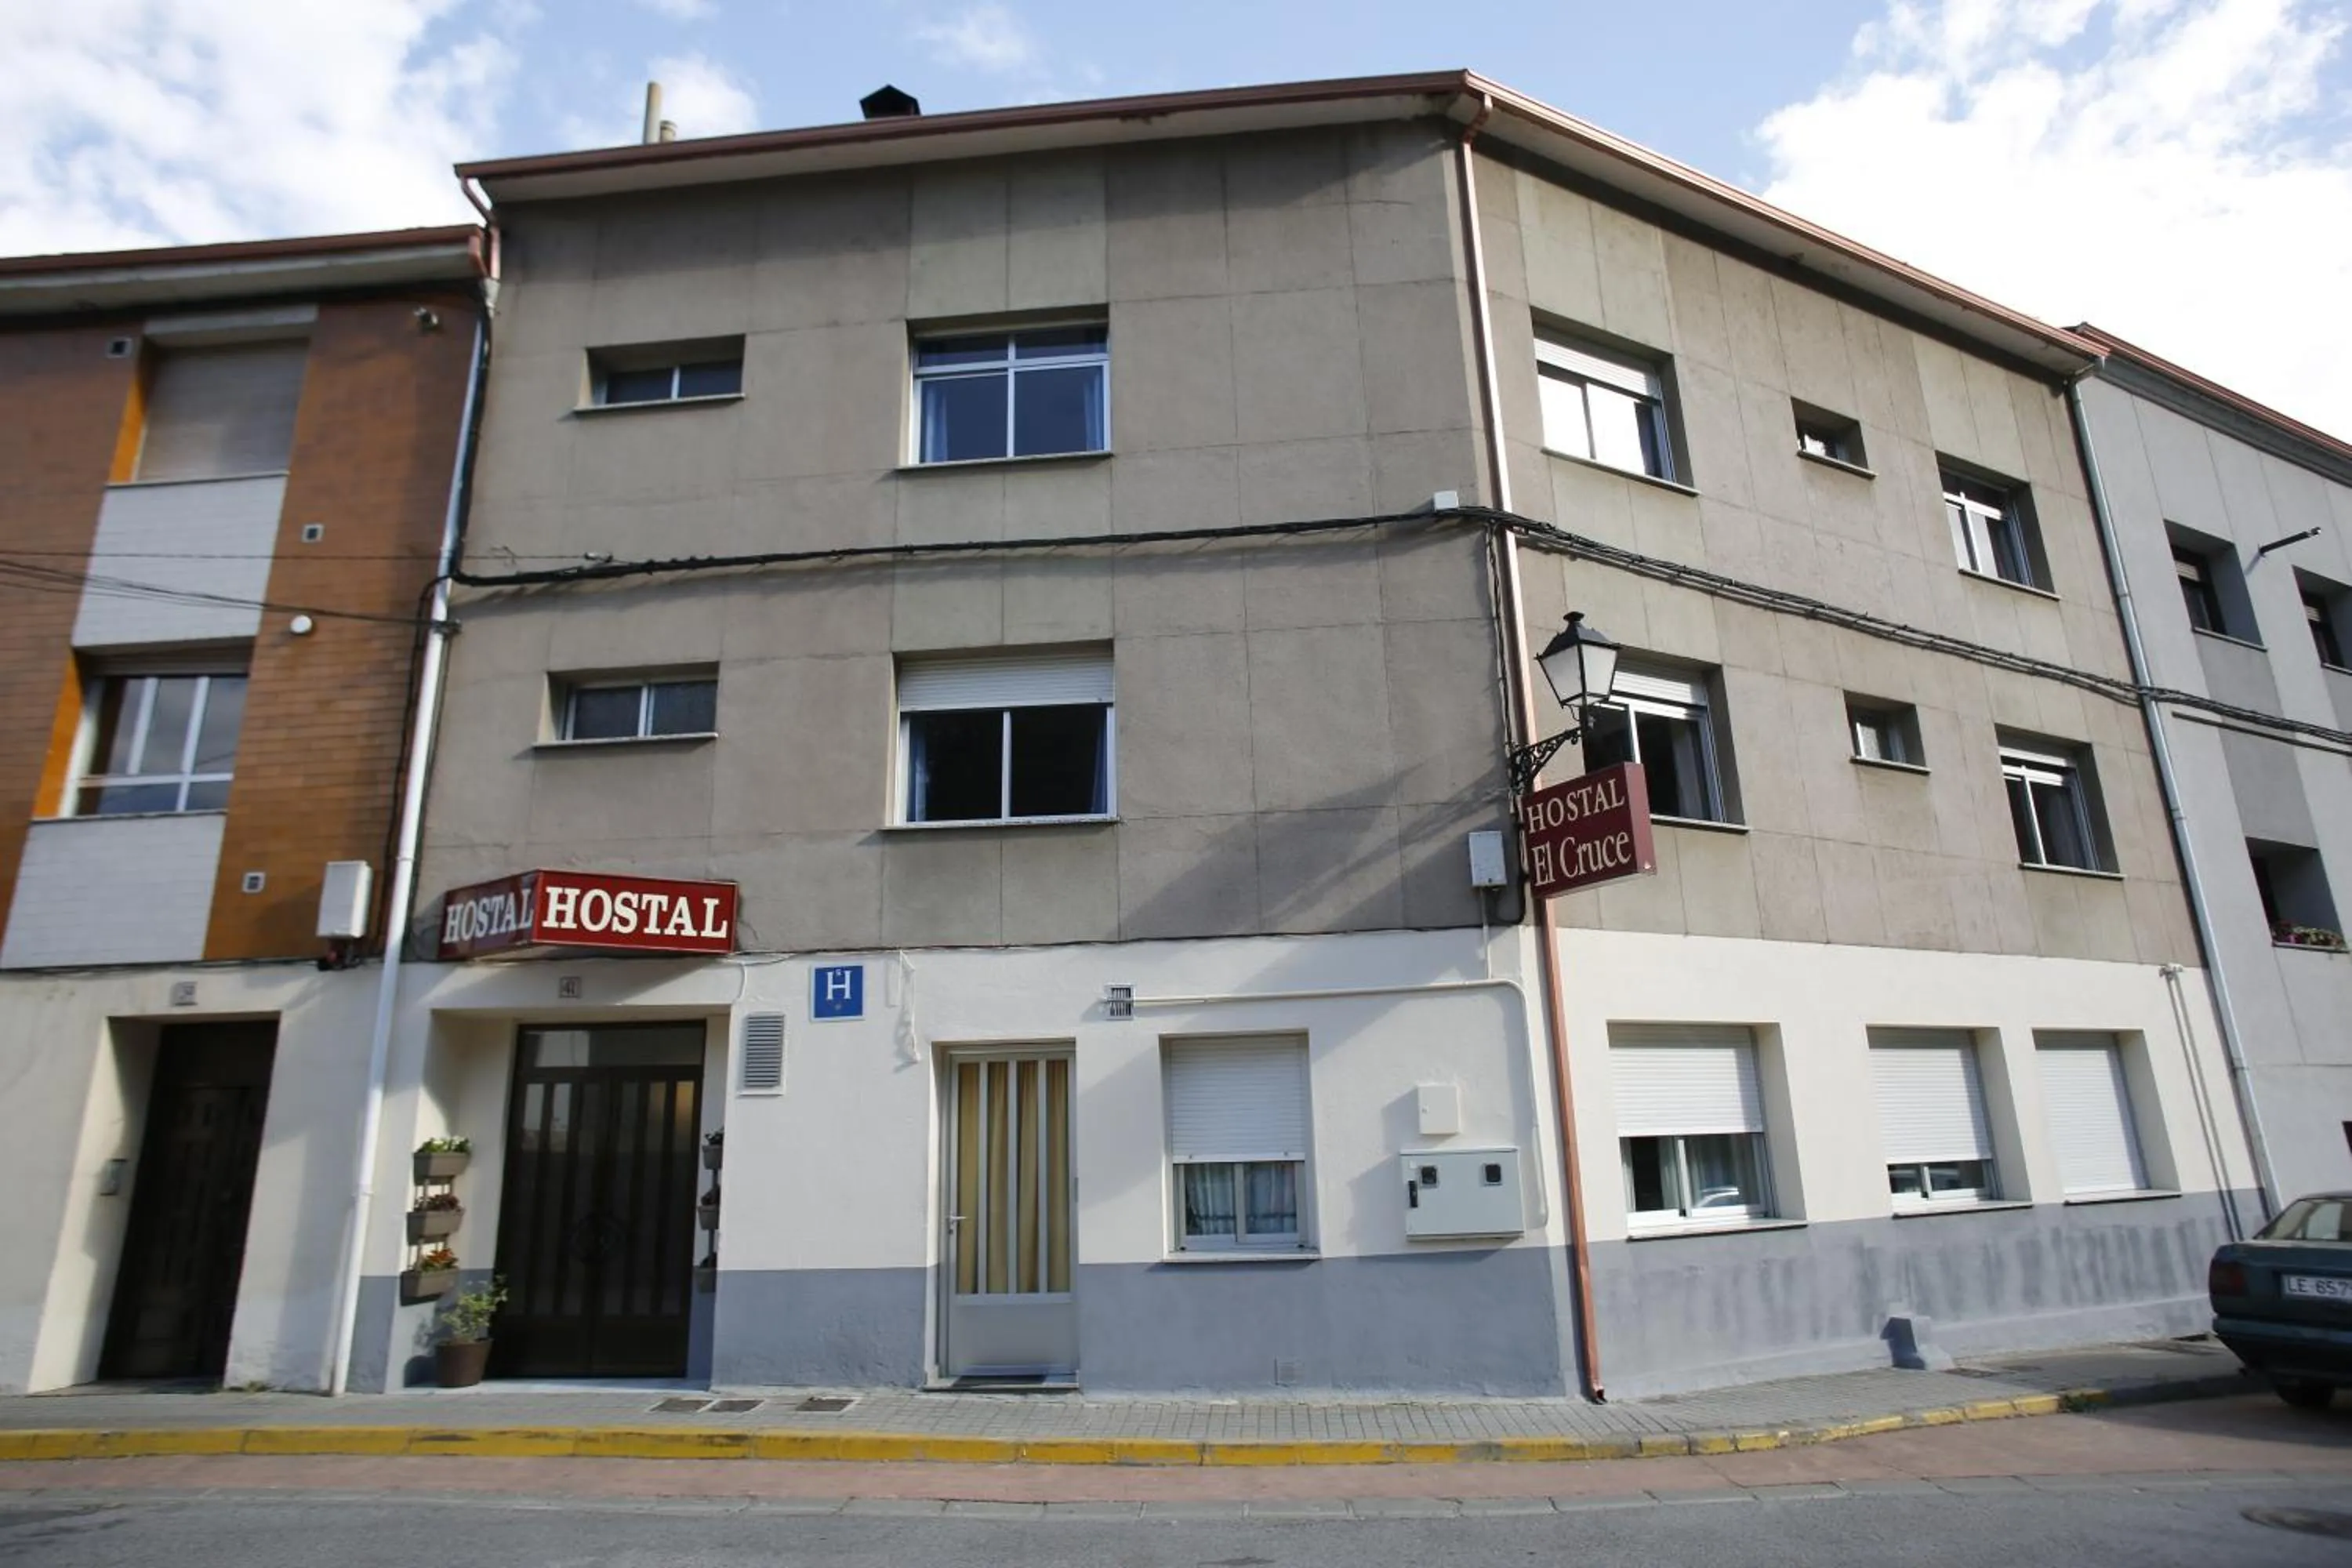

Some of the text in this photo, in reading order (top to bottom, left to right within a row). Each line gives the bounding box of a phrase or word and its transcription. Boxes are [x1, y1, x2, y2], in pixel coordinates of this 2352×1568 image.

[1527, 779, 1624, 833] HOSTAL
[1531, 831, 1632, 887] El Cruce
[443, 888, 534, 943] HOSTAL
[542, 886, 728, 939] HOSTAL
[826, 970, 851, 1000] H
[2288, 1277, 2352, 1297] LE 657
